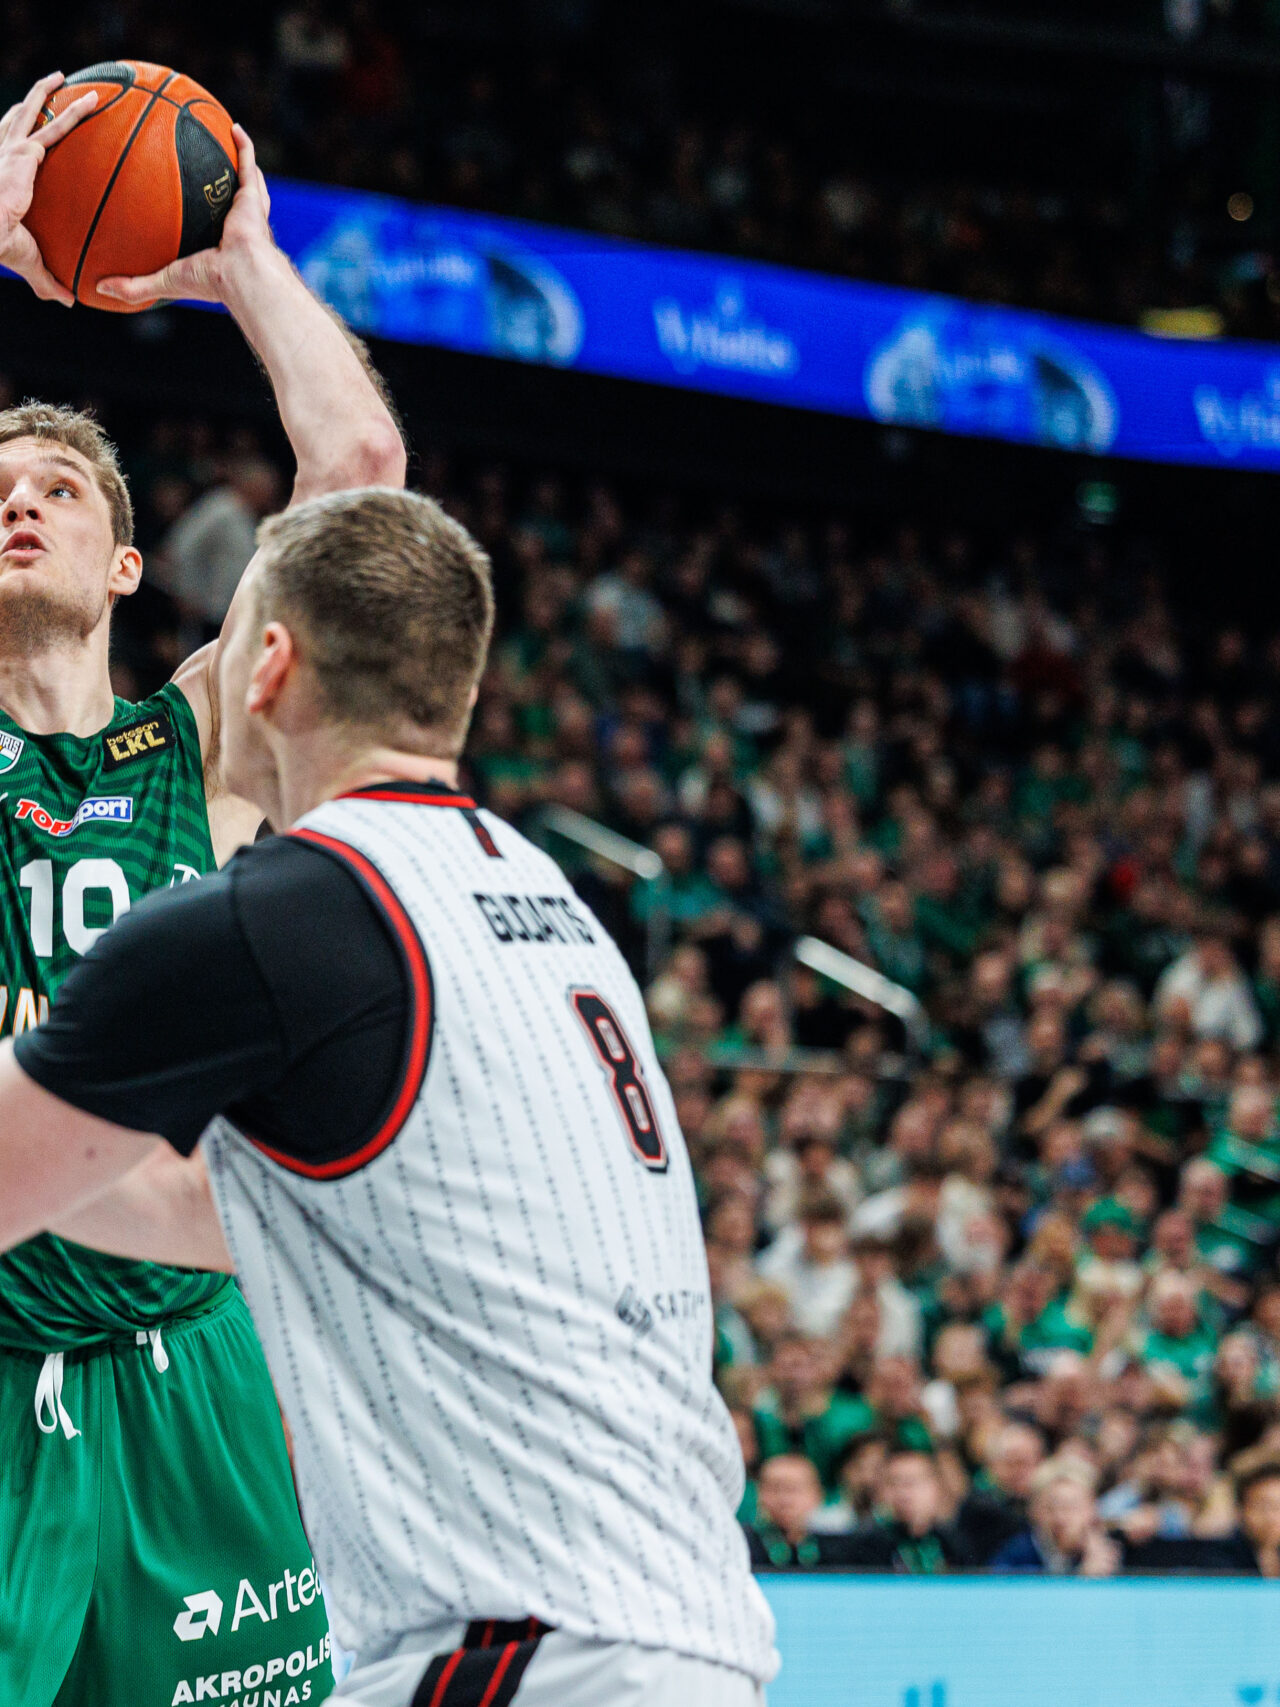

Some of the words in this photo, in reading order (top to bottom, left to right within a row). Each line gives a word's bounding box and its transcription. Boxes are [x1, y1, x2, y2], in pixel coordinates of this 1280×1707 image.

[110, 729, 166, 761] LKL
[20, 857, 131, 957] 10
[566, 984, 669, 1174] 8
